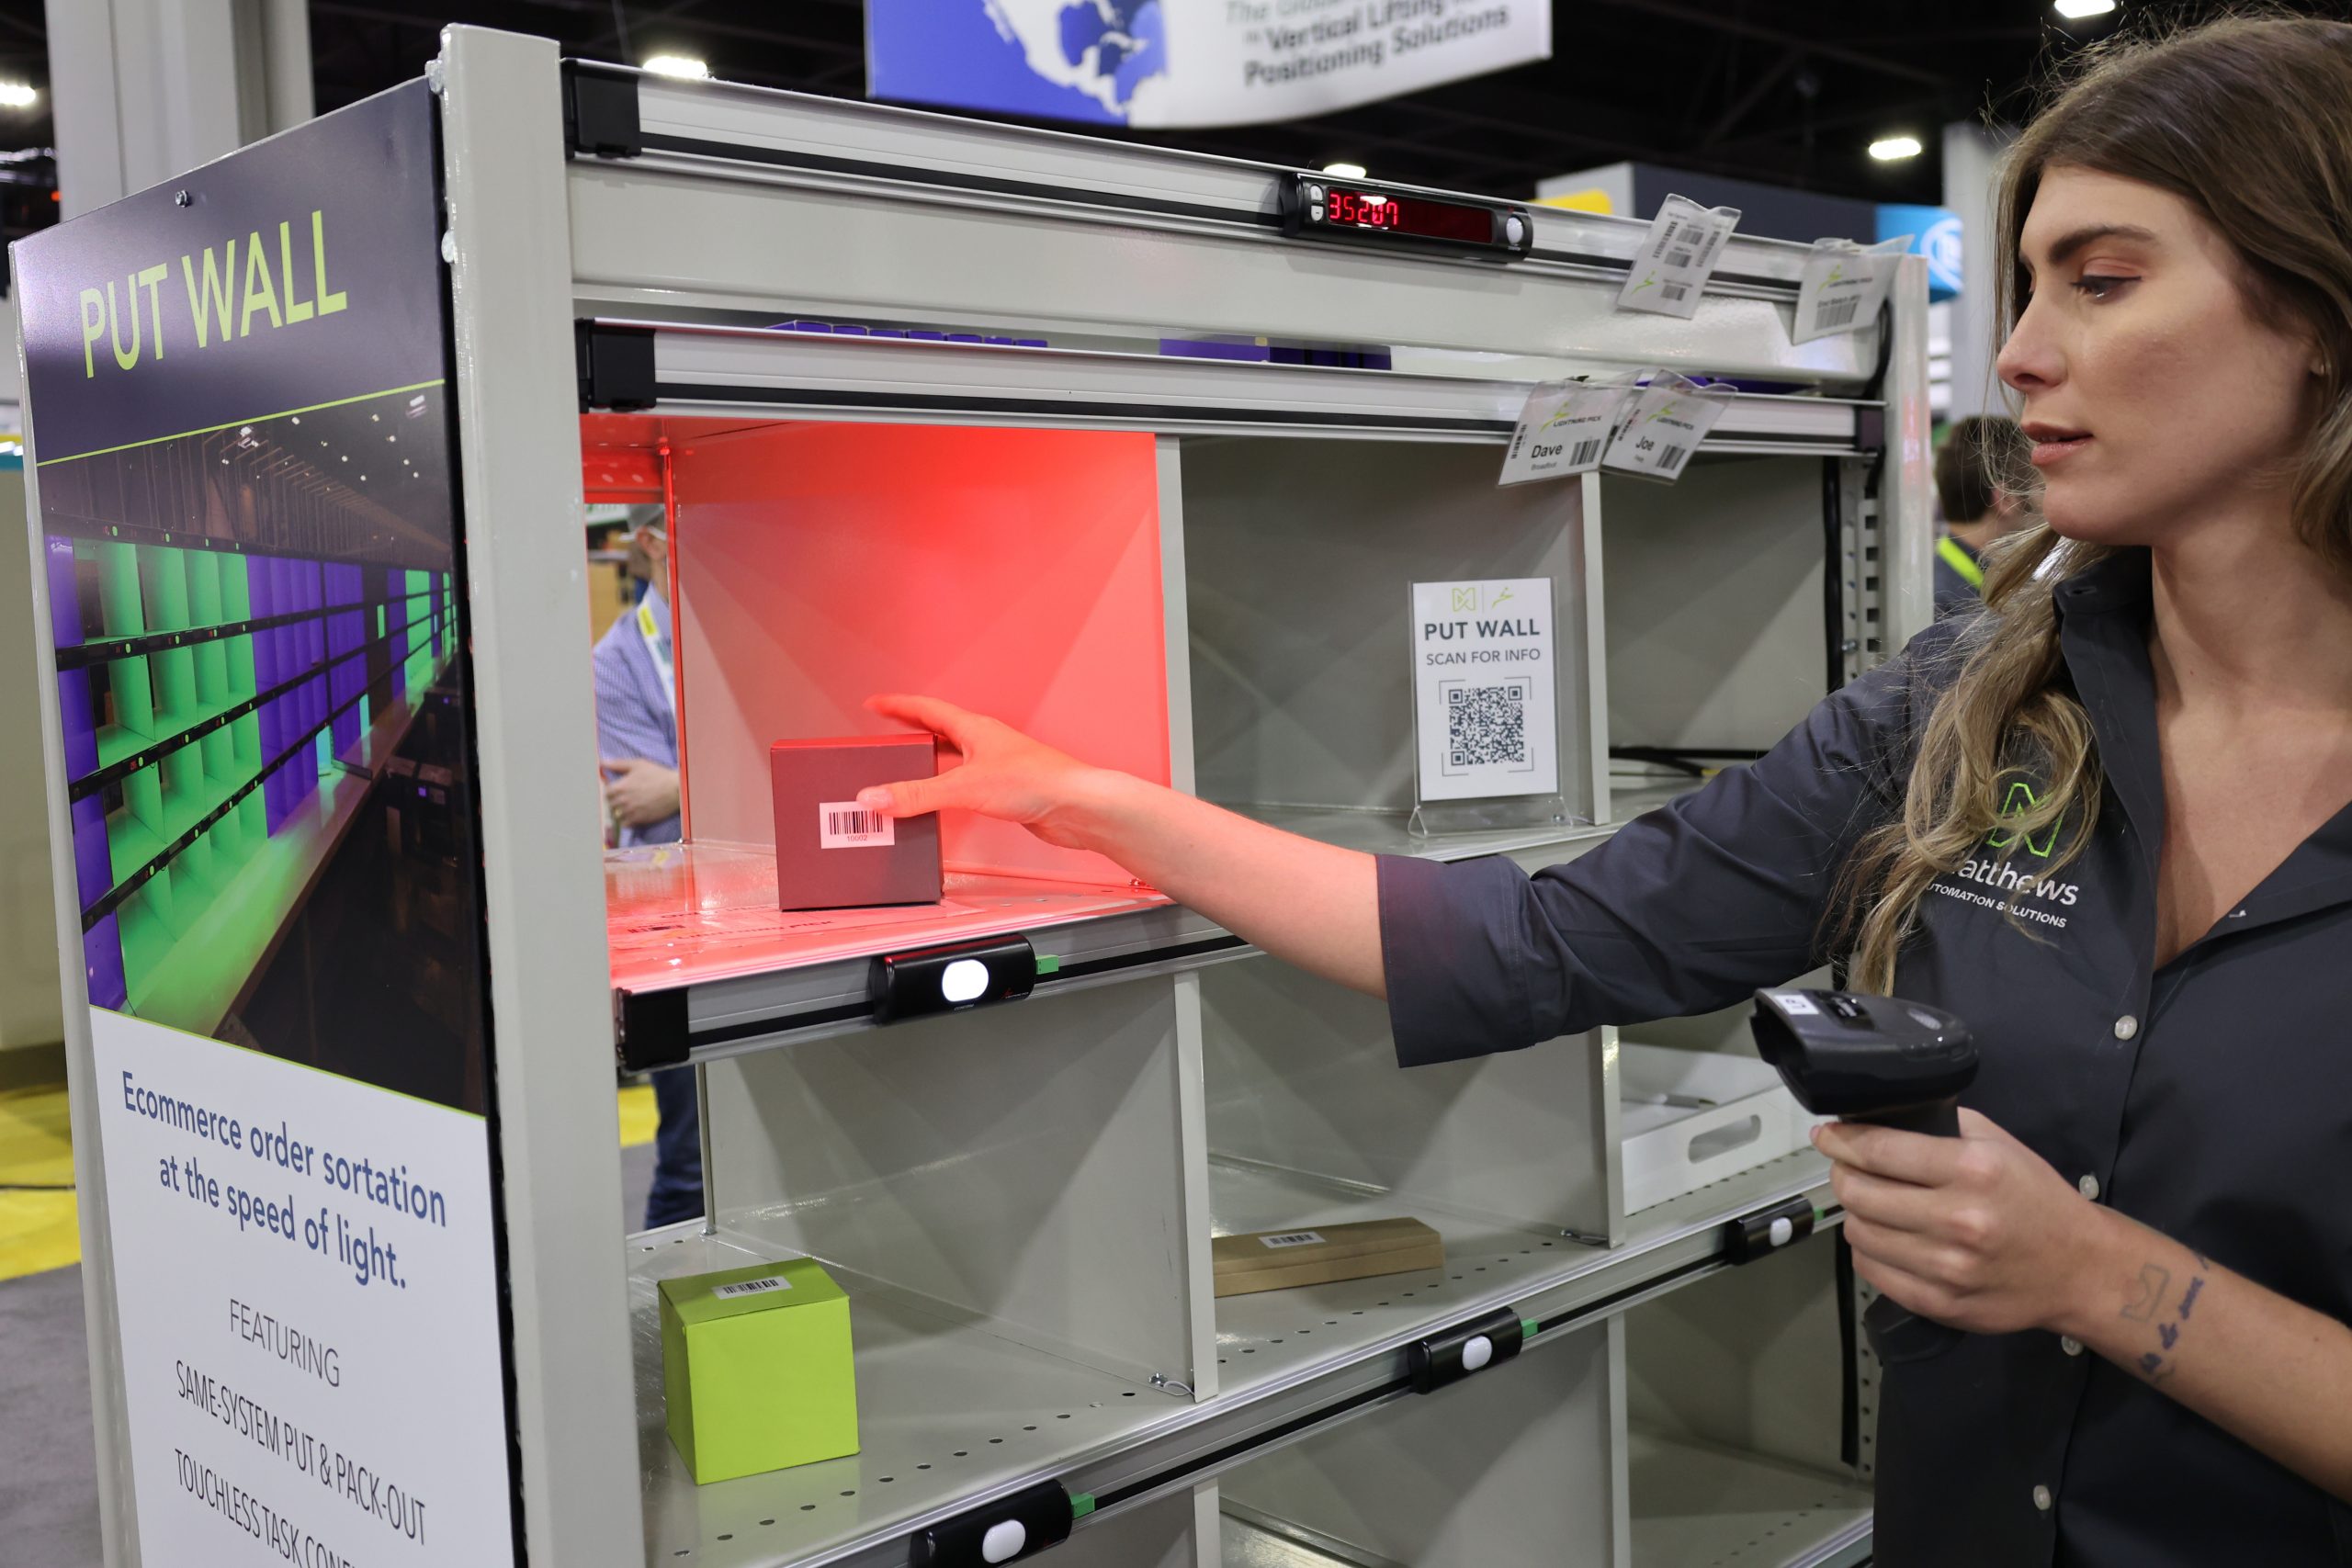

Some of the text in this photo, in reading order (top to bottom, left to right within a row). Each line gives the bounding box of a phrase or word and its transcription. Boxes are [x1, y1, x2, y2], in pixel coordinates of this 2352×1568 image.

[1244, 6, 1510, 88] Positioning Solutions
[1264, 14, 1363, 51] Vertical
[80, 209, 348, 378] PUT WALL
[1531, 444, 1564, 459] Dave
[1635, 435, 1655, 452] Joe
[1424, 618, 1541, 641] PUT WALL
[1426, 648, 1541, 666] SCAN FOR INFO
[1927, 883, 2068, 929] UTOMATION SOLUTIONS
[1952, 859, 2079, 906] atthews
[122, 1070, 446, 1228] Ecommerce order sortation
[160, 1155, 406, 1290] at the speed of light.
[230, 1298, 340, 1388] FEATURING
[175, 1359, 425, 1546] SAME-SYSTEM PUT & PACK-OUT
[175, 1448, 261, 1539] TOUCHLESS
[261, 1506, 302, 1568] TASK
